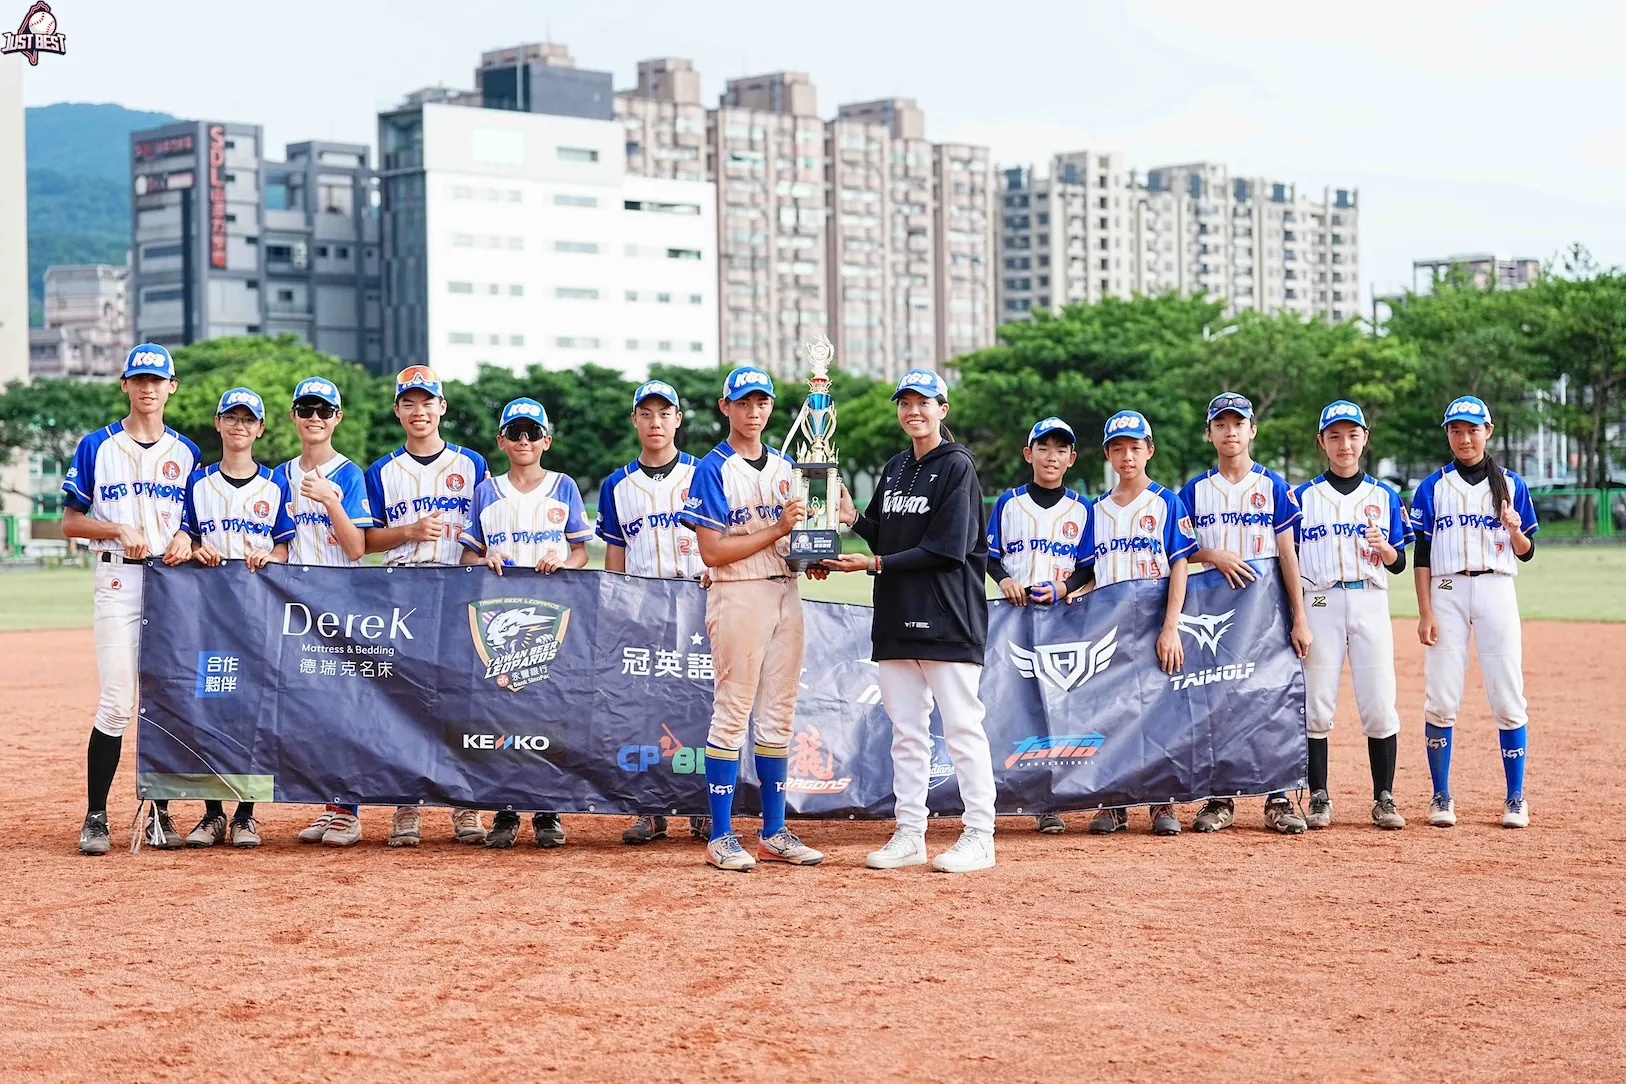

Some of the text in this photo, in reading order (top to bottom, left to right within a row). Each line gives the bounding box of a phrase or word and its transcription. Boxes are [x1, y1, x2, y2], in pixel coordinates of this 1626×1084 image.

[1109, 416, 1140, 433] KGB
[100, 483, 128, 501] KGB
[199, 520, 215, 535] GB
[1301, 525, 1327, 542] KGB
[1006, 540, 1024, 554] GB
[1137, 561, 1161, 579] 15
[301, 643, 395, 657] Mattress & Bedding
[487, 640, 560, 668] TAIWAN BEER
[207, 656, 239, 673] 合作
[299, 658, 394, 678] 德瑞克名床
[484, 648, 558, 680] LEOPARDS
[205, 676, 237, 693] 夥伴
[513, 679, 528, 688] Bank
[1170, 661, 1256, 691] TAIWOLF
[709, 783, 734, 796] KGB
